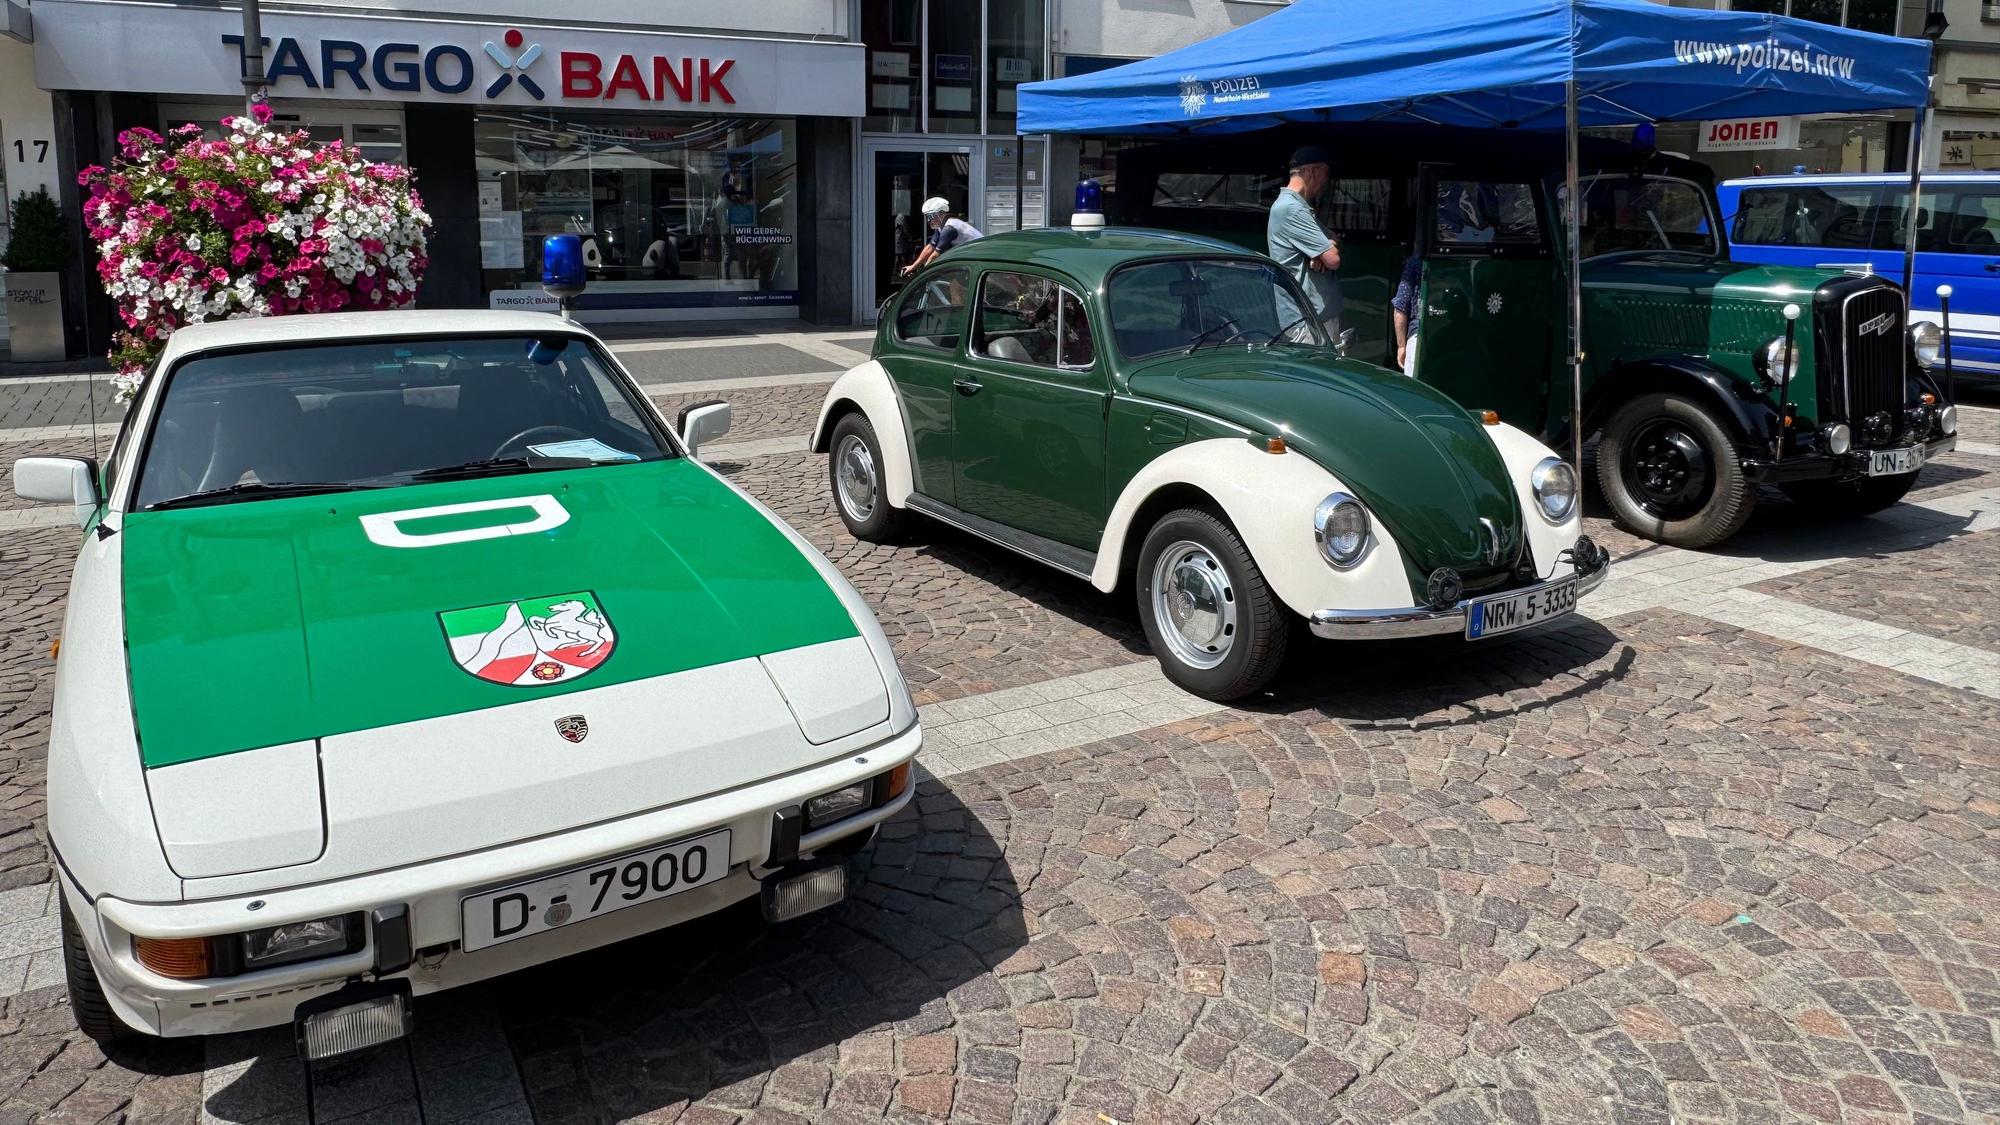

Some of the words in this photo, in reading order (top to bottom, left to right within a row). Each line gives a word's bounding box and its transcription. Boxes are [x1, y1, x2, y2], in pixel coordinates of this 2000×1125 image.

[1674, 35, 1855, 80] www.polizei.nrw
[222, 34, 474, 94] TARGO
[561, 52, 737, 105] BANK
[1211, 76, 1260, 94] POLIZEI
[1708, 121, 1778, 141] JONEN
[14, 139, 49, 163] 17
[735, 227, 752, 235] WIR
[735, 234, 792, 244] RÜCKENWIND
[1483, 599, 1518, 630] NRW
[1526, 582, 1576, 620] 5-3333
